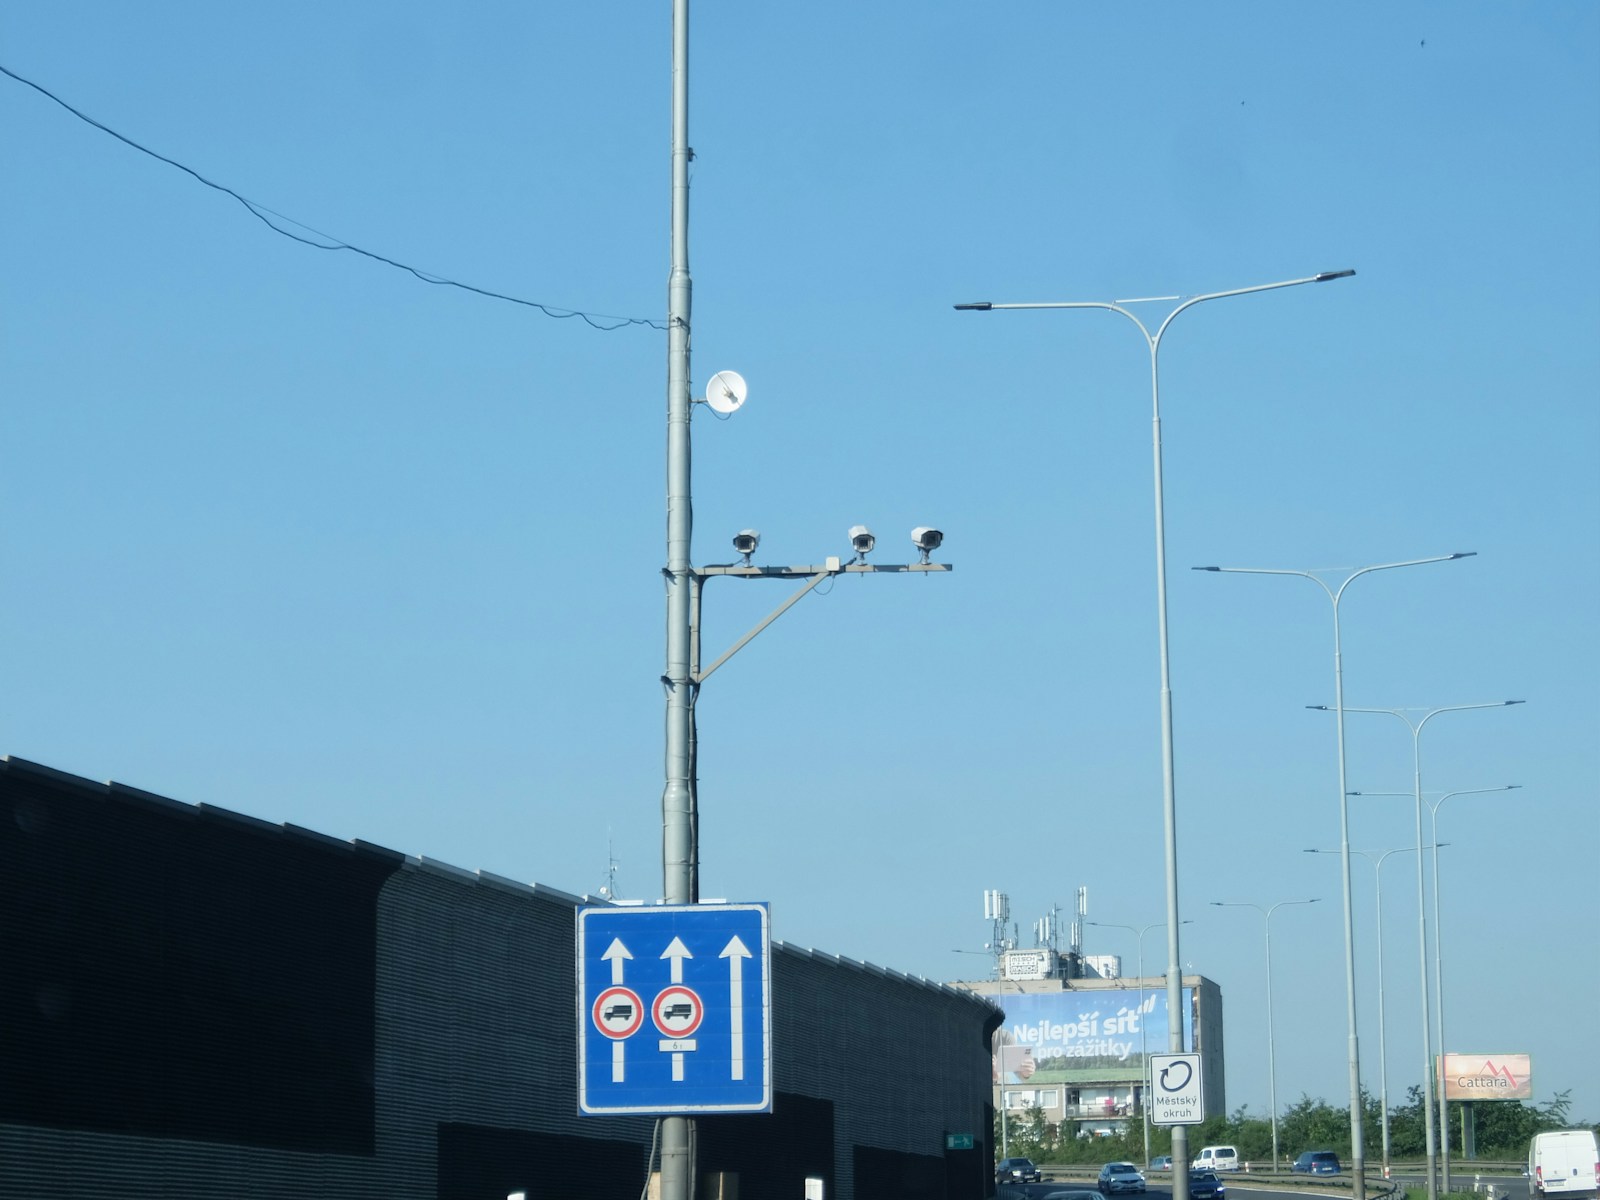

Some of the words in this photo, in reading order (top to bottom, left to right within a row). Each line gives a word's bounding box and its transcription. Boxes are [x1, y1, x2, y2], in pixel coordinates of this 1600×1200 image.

[1013, 1011, 1100, 1046] Nejlepší
[673, 1042, 678, 1050] 6
[1037, 1046, 1063, 1063] pro
[1065, 1038, 1133, 1061] zážitky
[1458, 1077, 1508, 1088] Cattara
[1156, 1096, 1197, 1107] Městský
[1163, 1109, 1192, 1118] okruh
